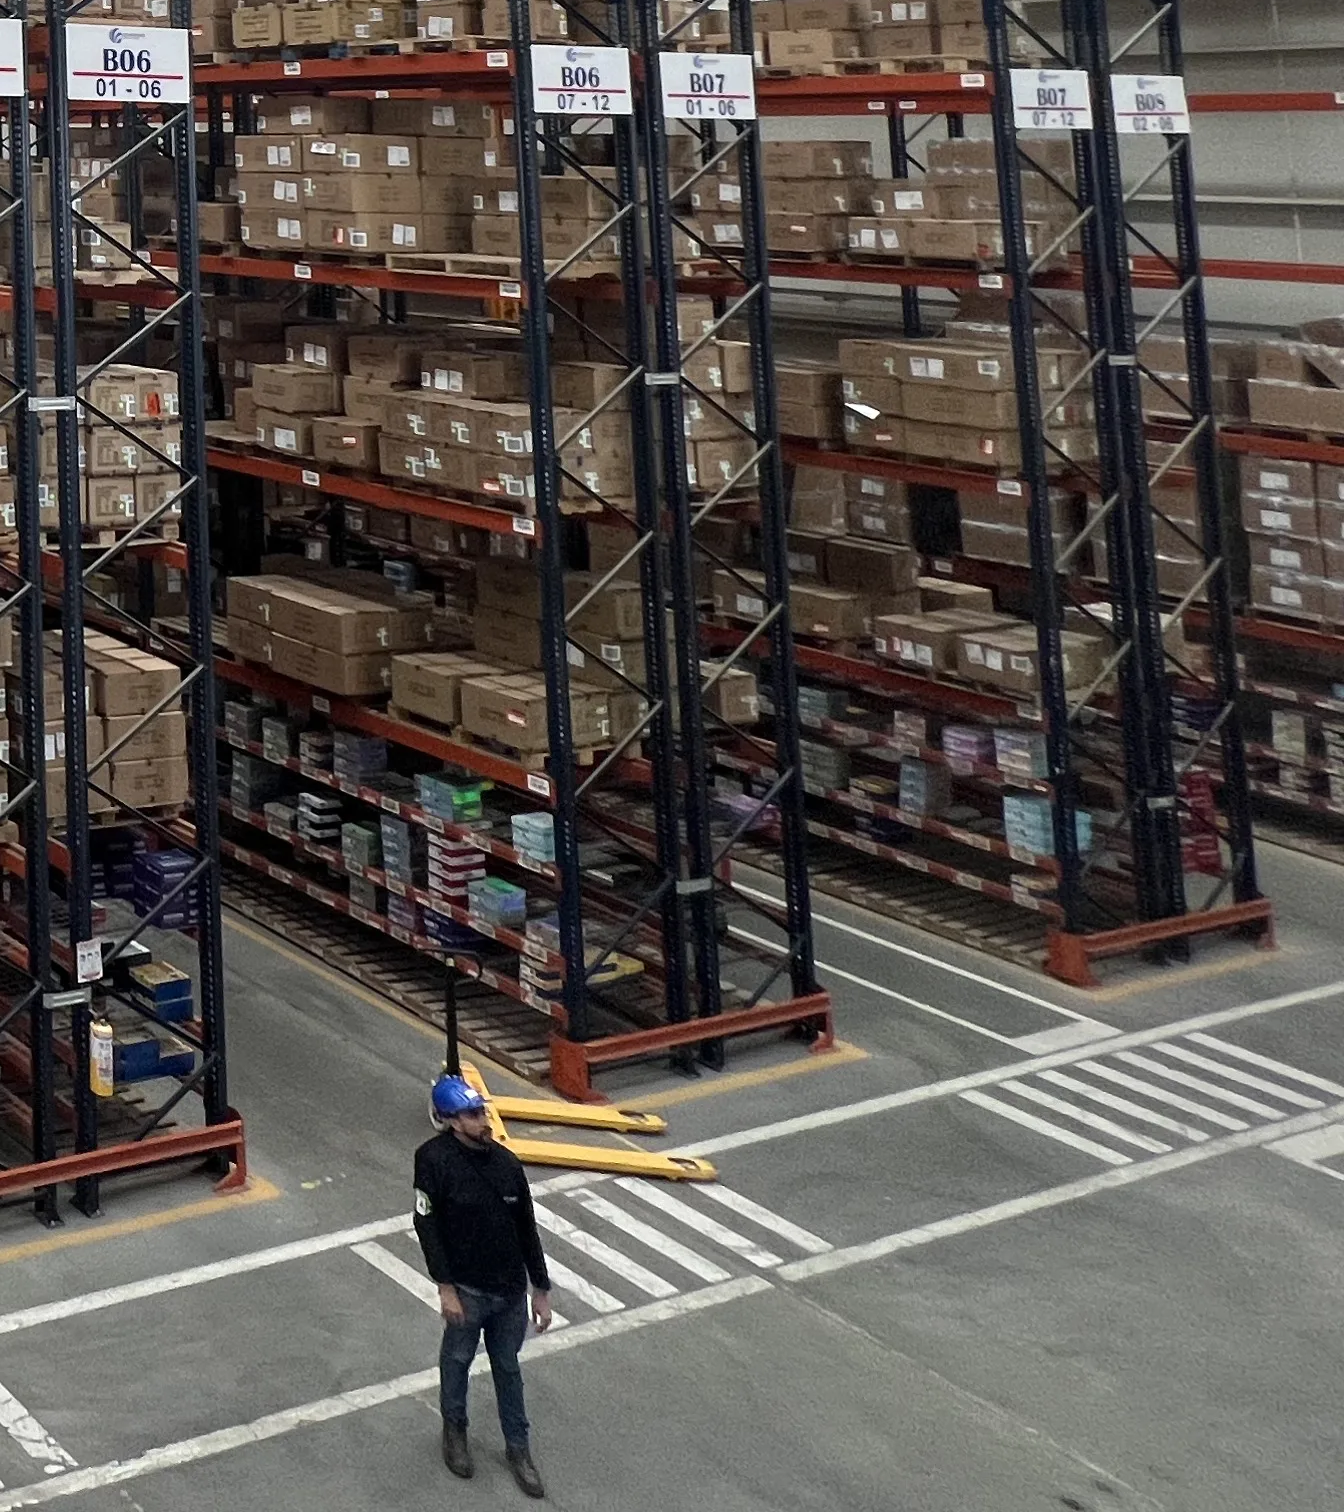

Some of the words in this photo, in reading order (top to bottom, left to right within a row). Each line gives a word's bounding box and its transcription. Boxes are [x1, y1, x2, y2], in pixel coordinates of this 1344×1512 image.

[102, 48, 152, 74] B06
[561, 66, 600, 88] B06
[689, 72, 725, 94] B07
[96, 77, 117, 97] 01
[138, 79, 162, 99] 06
[1037, 87, 1067, 106] B07
[557, 93, 576, 110] 07
[591, 94, 611, 111] 12
[686, 98, 702, 115] 01
[718, 99, 736, 116] 06
[1032, 111, 1047, 126] 07
[1060, 111, 1075, 127] 12
